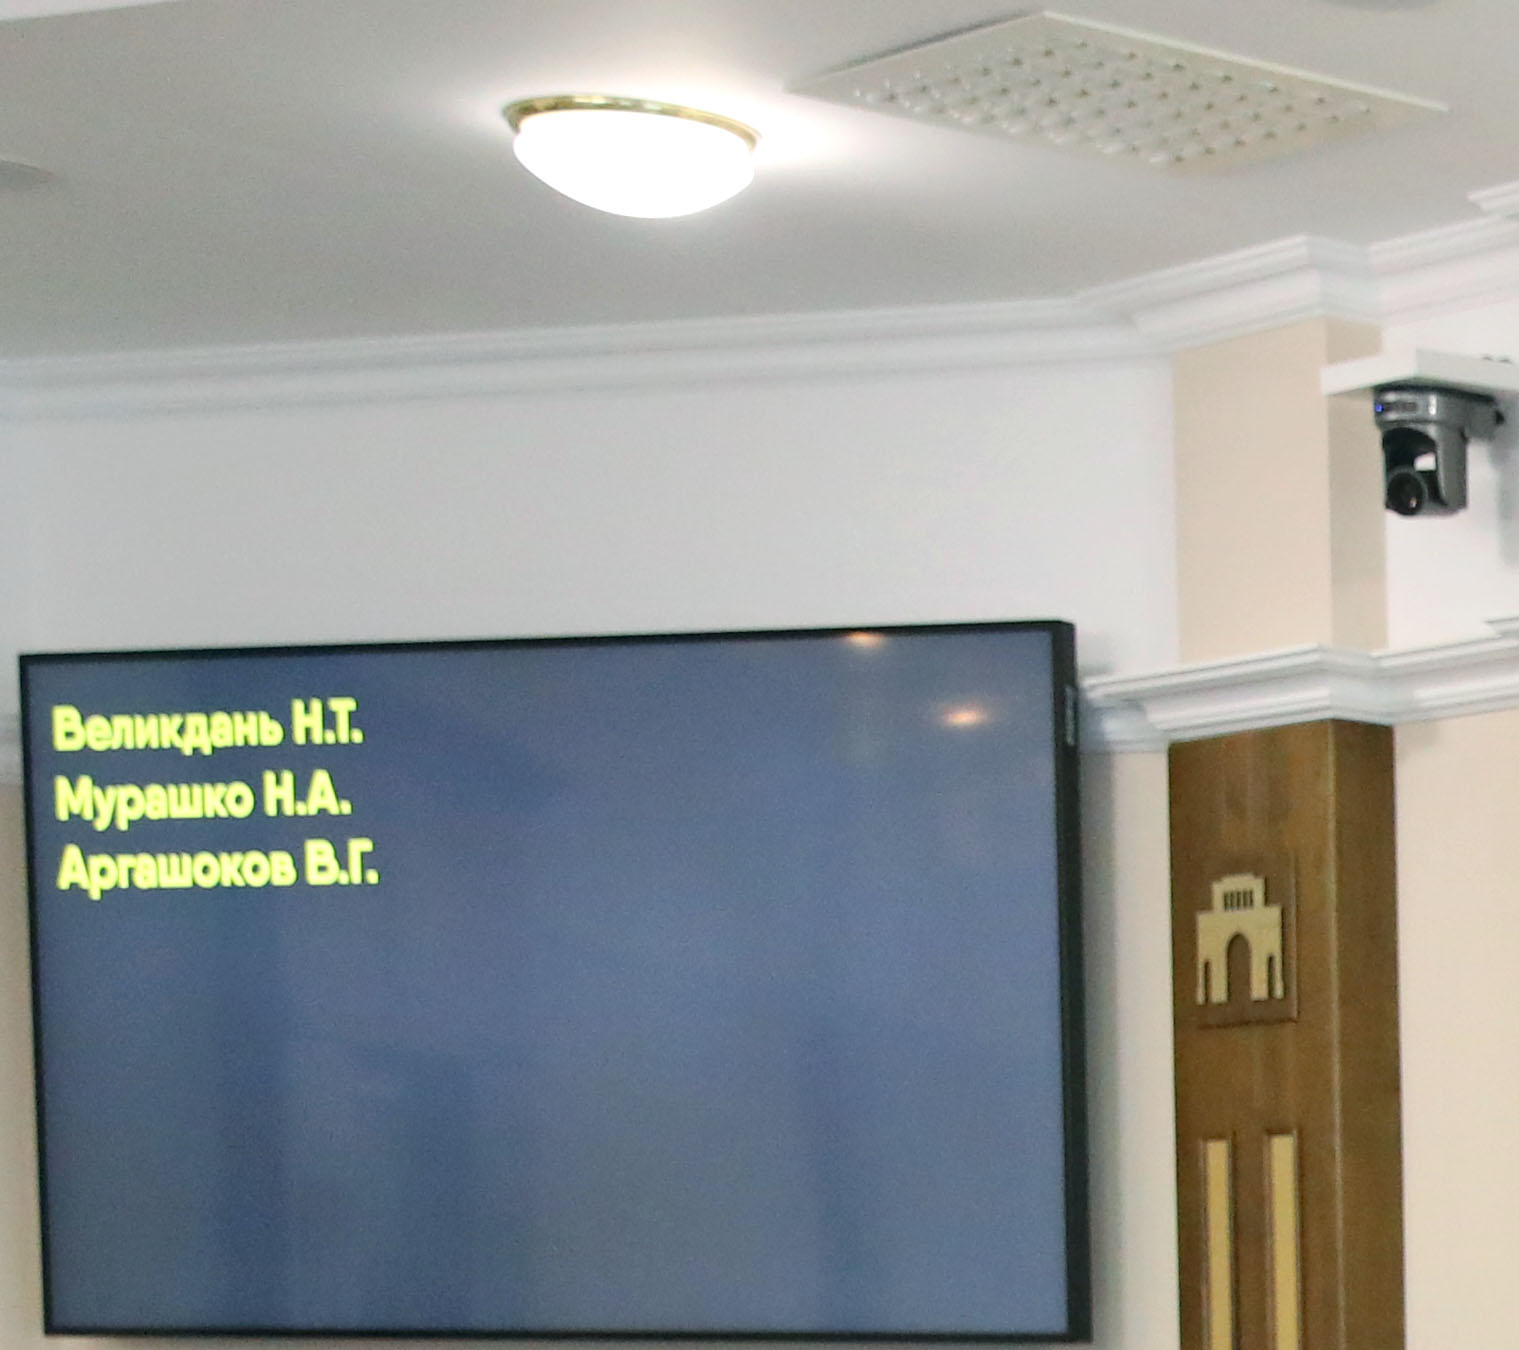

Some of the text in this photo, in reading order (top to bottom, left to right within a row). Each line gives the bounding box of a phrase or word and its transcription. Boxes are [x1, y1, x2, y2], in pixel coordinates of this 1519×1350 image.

[52, 697, 363, 755] Великдань Н.Т.
[54, 769, 352, 831] Мурашко Н.А.
[57, 838, 379, 900] Аргашоков В.Г.
